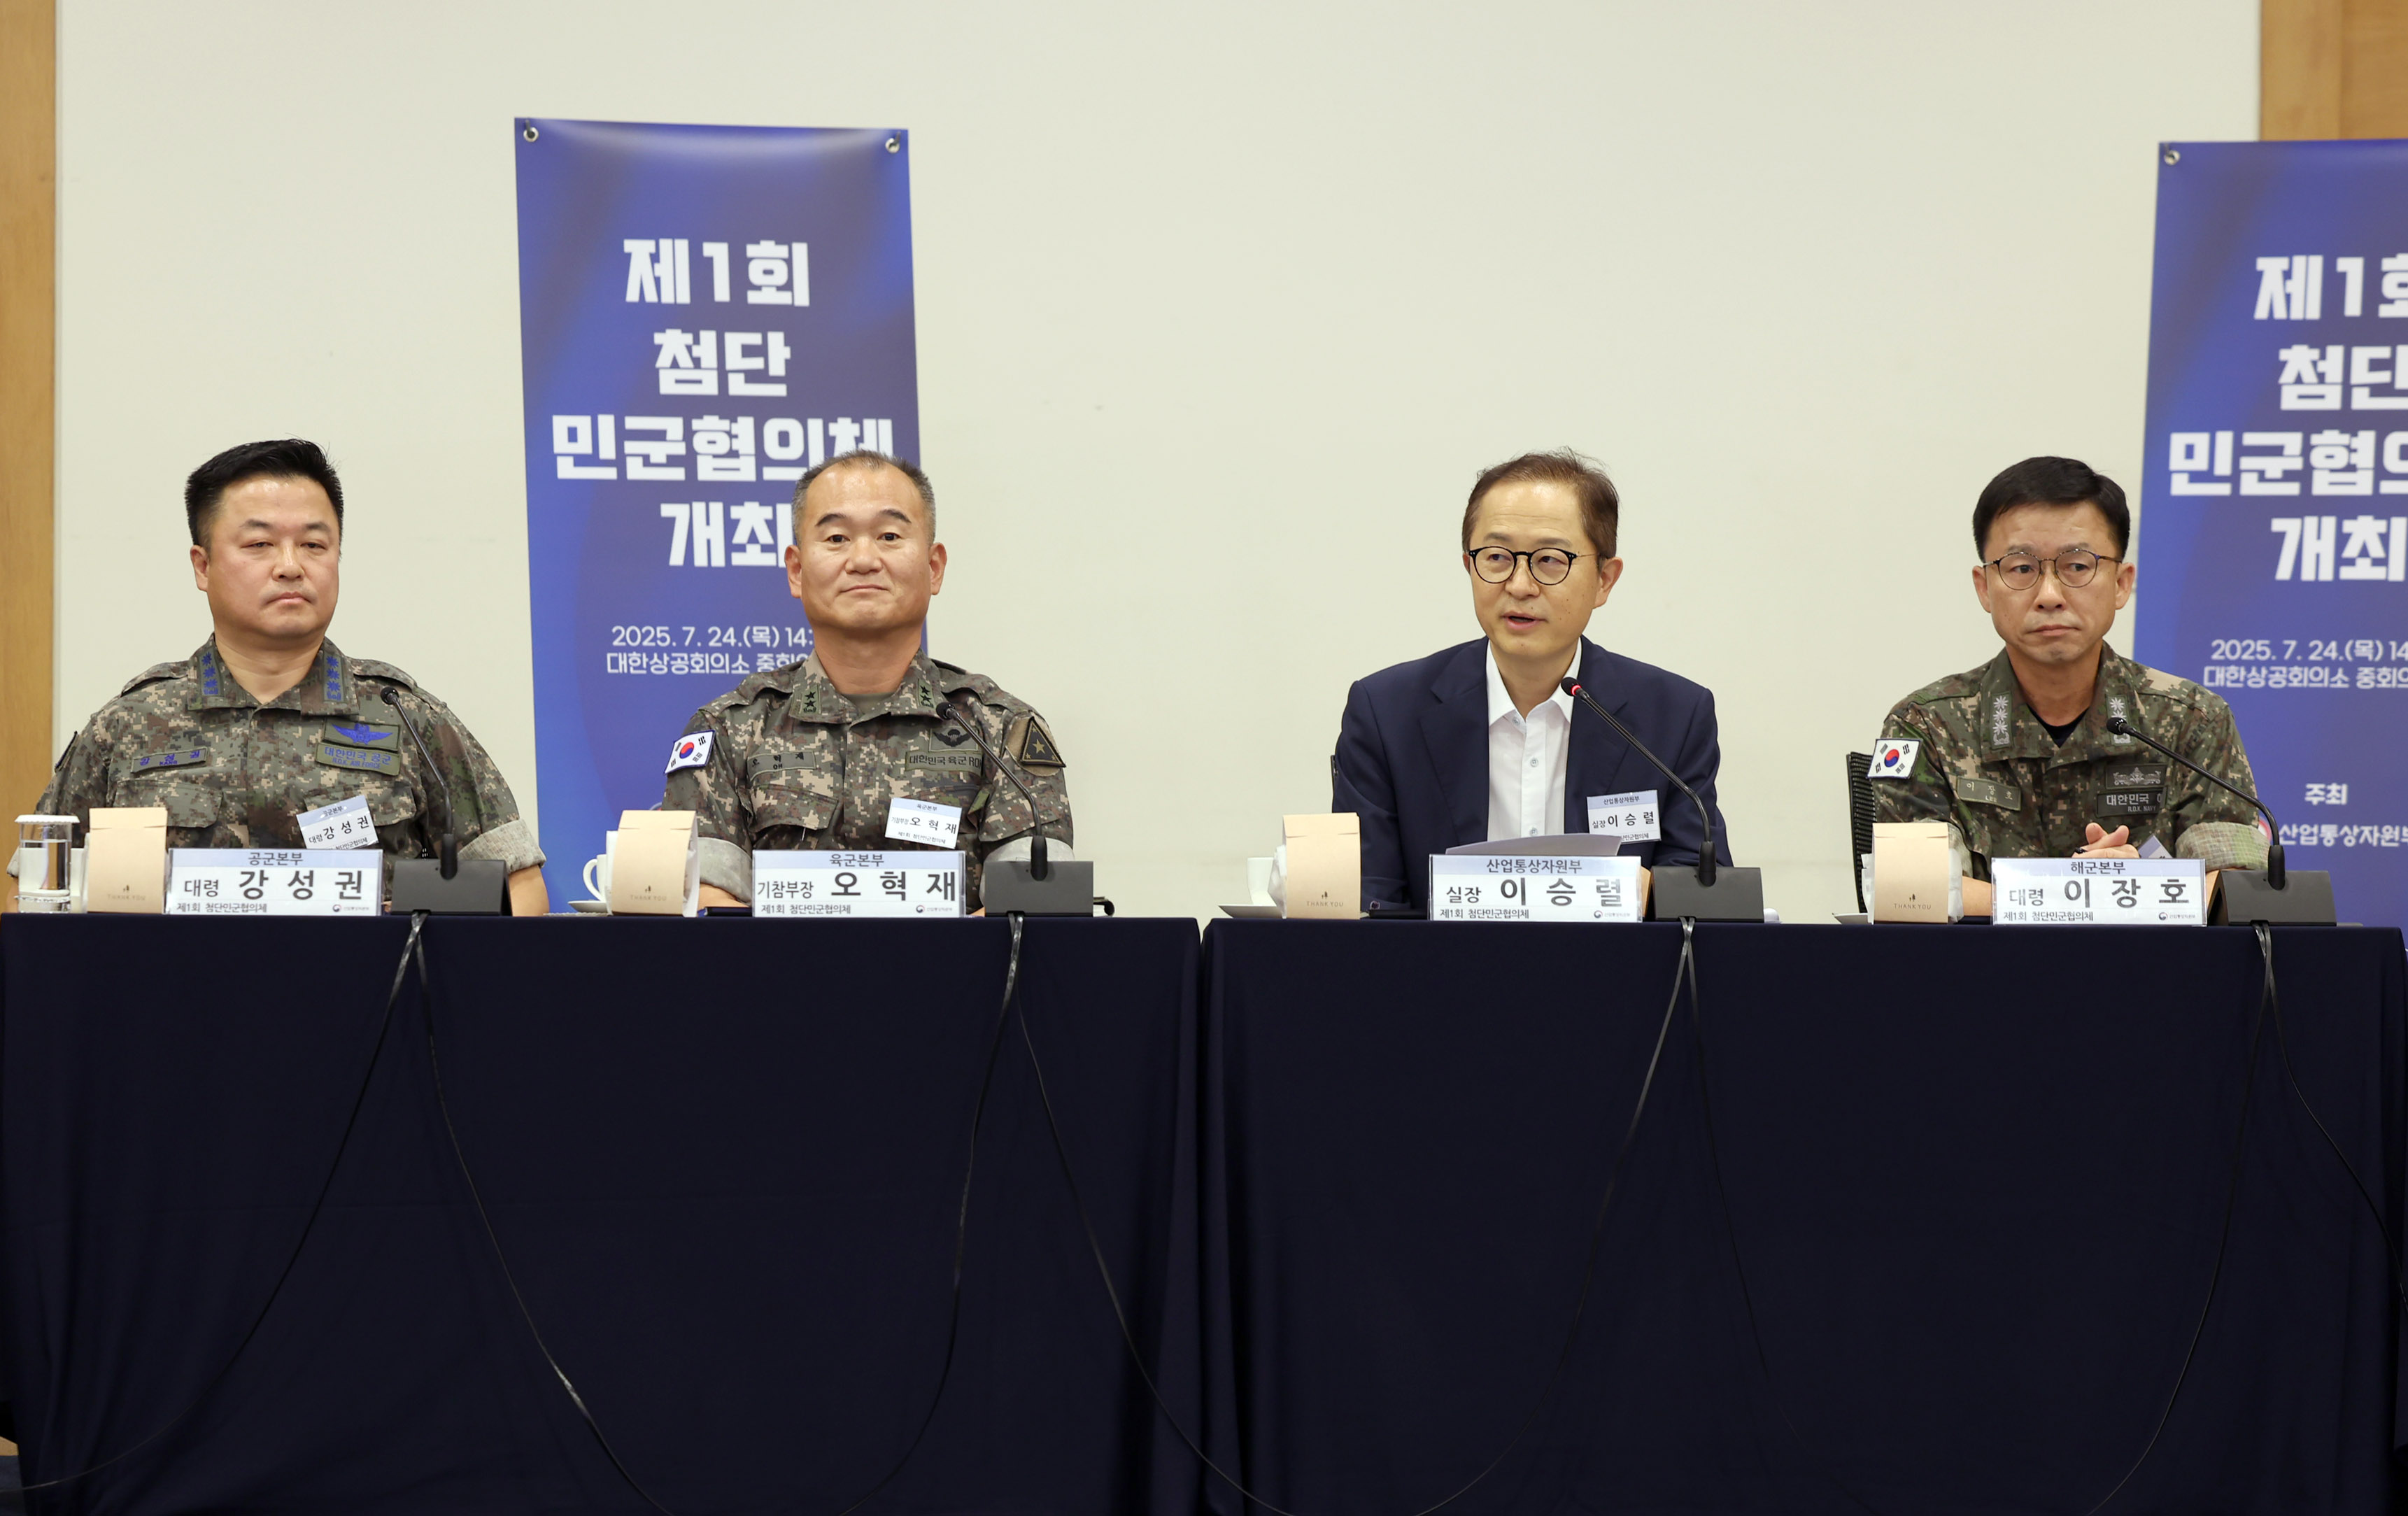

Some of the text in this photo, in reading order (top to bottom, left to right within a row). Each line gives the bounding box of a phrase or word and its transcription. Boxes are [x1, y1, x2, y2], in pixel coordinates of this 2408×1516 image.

[623, 239, 810, 307] 제1회
[653, 328, 791, 397] 첨단
[2278, 345, 2408, 411] 첨단
[660, 501, 793, 568] 개최
[2270, 515, 2407, 581] 개최
[611, 625, 677, 647] 2025.
[682, 626, 701, 647] 7.
[708, 625, 780, 648] 24.(목)
[2211, 639, 2276, 661] 2025.
[2282, 639, 2302, 661] 7.
[2308, 639, 2384, 662] 24.(목)
[607, 651, 750, 674] 대한상공회의소
[2204, 665, 2350, 689] 대한상공회의소
[324, 746, 392, 765] 대한민국 공군
[909, 754, 946, 766] 대한민국
[947, 756, 968, 766] 육군
[1603, 795, 1641, 805] 산업통상자원부
[2106, 793, 2150, 806] 대한민국
[2304, 782, 2349, 806] 주최
[1592, 820, 1606, 829] 실장
[309, 834, 323, 844] 대령
[248, 851, 304, 866] 공군본부
[829, 853, 884, 867] 육군본부
[1486, 858, 1583, 874] 산업통상자원부
[2070, 860, 2126, 874] 해군본부
[184, 879, 219, 898] 대령
[757, 880, 814, 899] 기참부장
[1446, 886, 1482, 904] 실장
[2009, 888, 2044, 907] 대령
[176, 902, 267, 914] 제1회 첨단민군협의체
[761, 904, 851, 914] 제1회 첨단민군협의체
[1440, 909, 1529, 919] 제1회 첨단민군협의체
[2003, 911, 2094, 922] 제1회 첨단민군협의체
